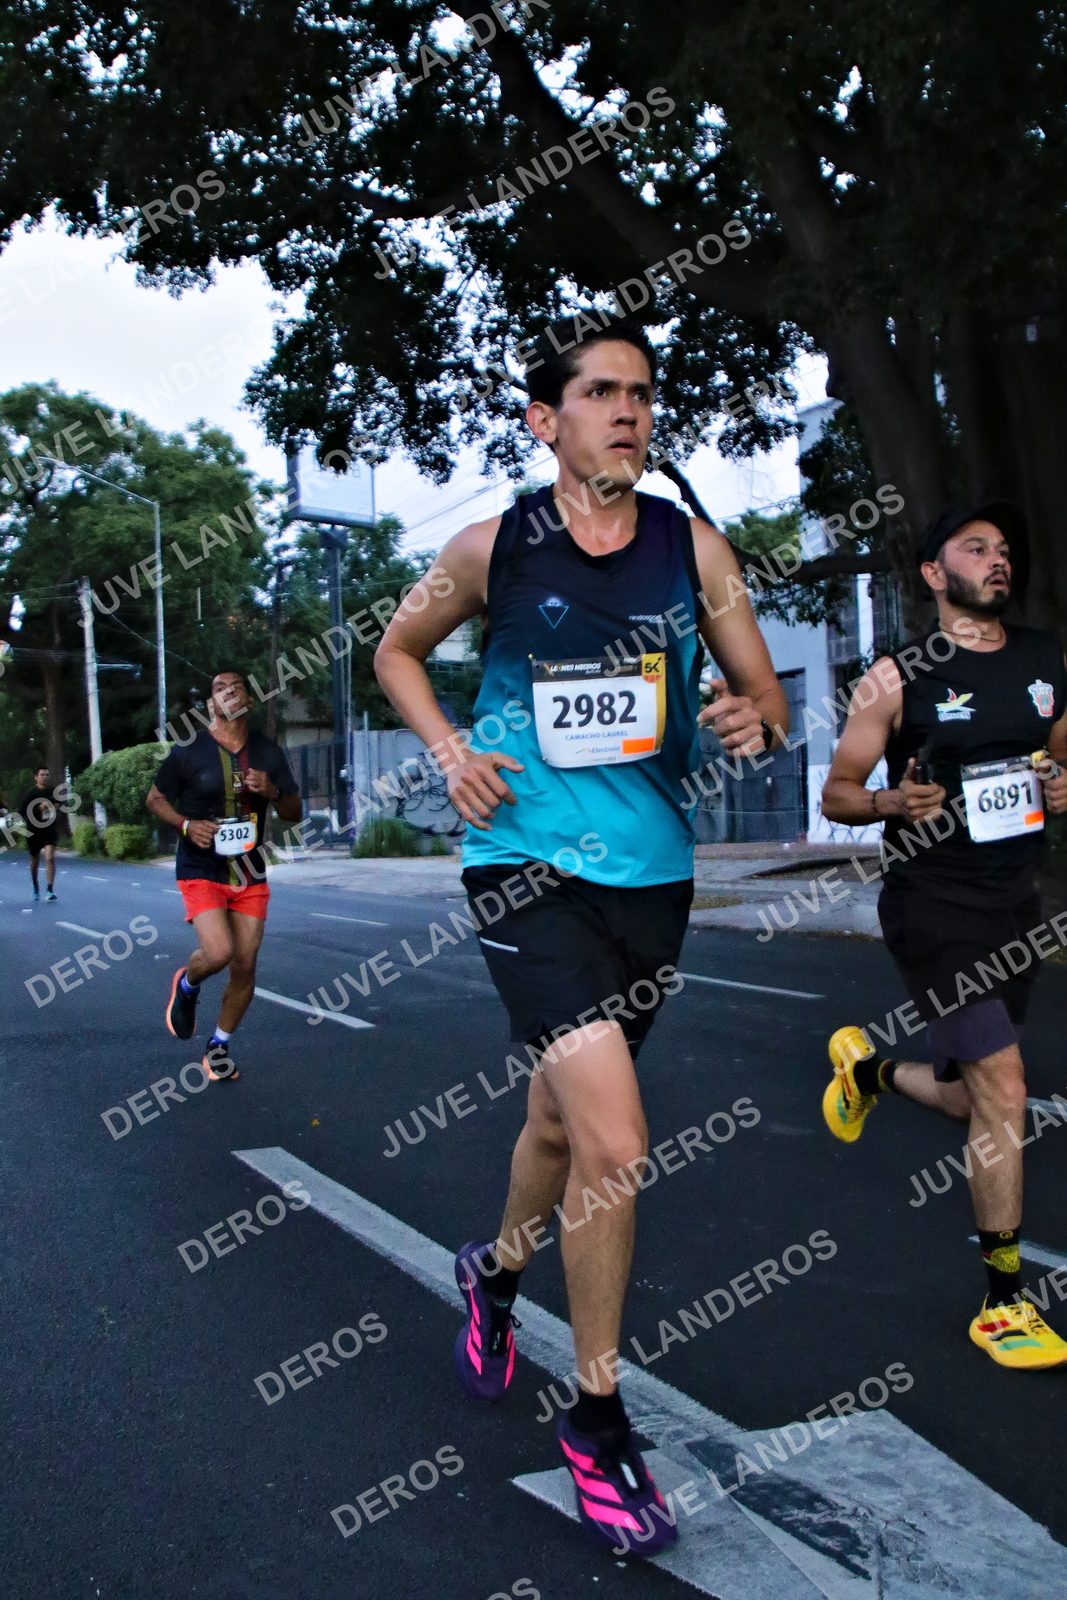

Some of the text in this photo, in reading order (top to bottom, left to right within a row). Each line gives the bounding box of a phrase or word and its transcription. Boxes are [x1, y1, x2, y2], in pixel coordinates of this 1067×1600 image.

[552, 690, 637, 729] 2982
[565, 731, 600, 741] CAMACHO
[977, 780, 1033, 813] 6891
[220, 827, 250, 842] 5302
